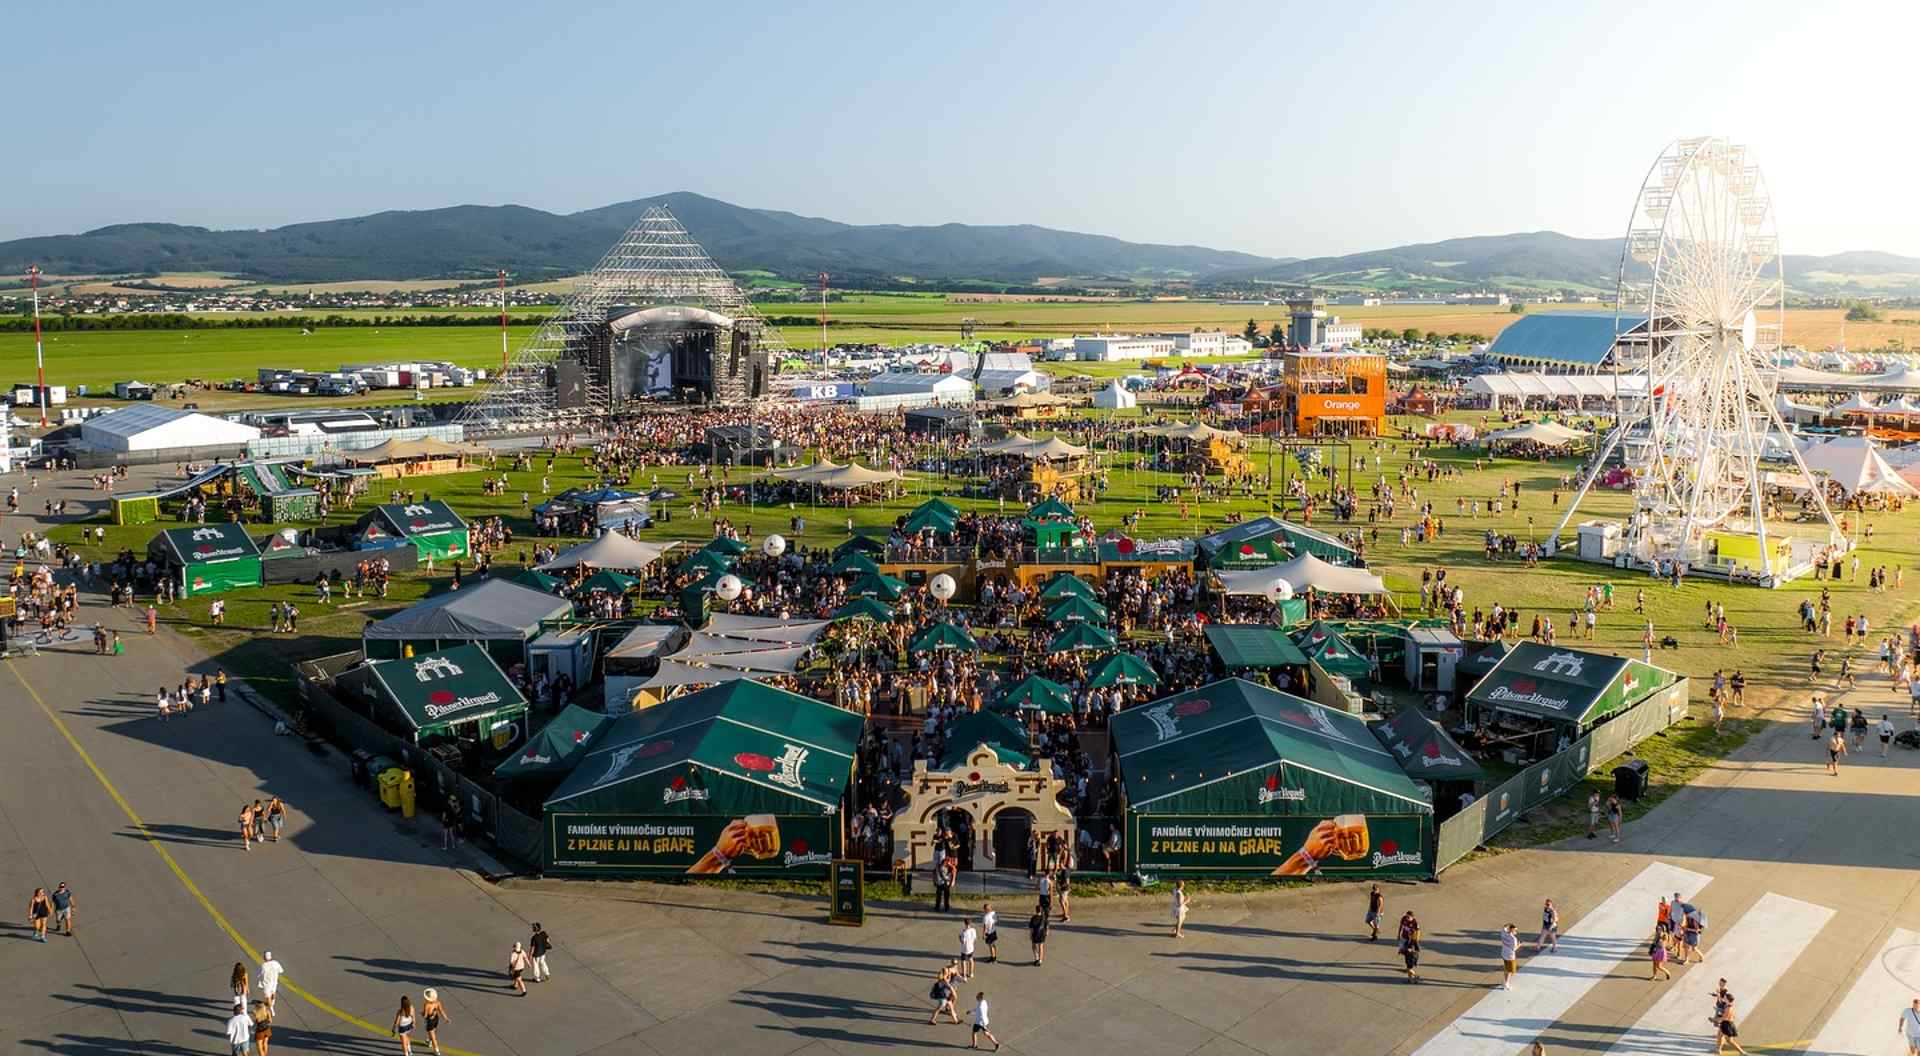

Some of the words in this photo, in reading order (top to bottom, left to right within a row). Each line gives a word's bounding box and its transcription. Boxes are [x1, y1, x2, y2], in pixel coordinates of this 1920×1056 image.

[811, 386, 838, 399] KB
[1324, 400, 1360, 411] Orange
[1489, 686, 1531, 702] Pilsner
[424, 701, 462, 720] Pilsner
[567, 823, 607, 835] FANDÍME
[609, 823, 665, 836] VÝNIMOČNEJ
[667, 825, 694, 836] CHUTI
[1151, 825, 1193, 837] FANDÍME
[1194, 824, 1252, 837] VÝNIMOČNEJ
[1254, 827, 1282, 837] CHUTI
[567, 839, 576, 850] Z
[579, 839, 614, 851] PLZNE
[617, 840, 630, 851] AJ
[634, 840, 650, 851] NA
[653, 837, 695, 855] GRAPE
[1151, 841, 1160, 853] Z
[1162, 841, 1199, 853] PLZNE
[1202, 841, 1216, 853] AJ
[1219, 841, 1236, 853] NA
[1239, 838, 1282, 856] GRAPE
